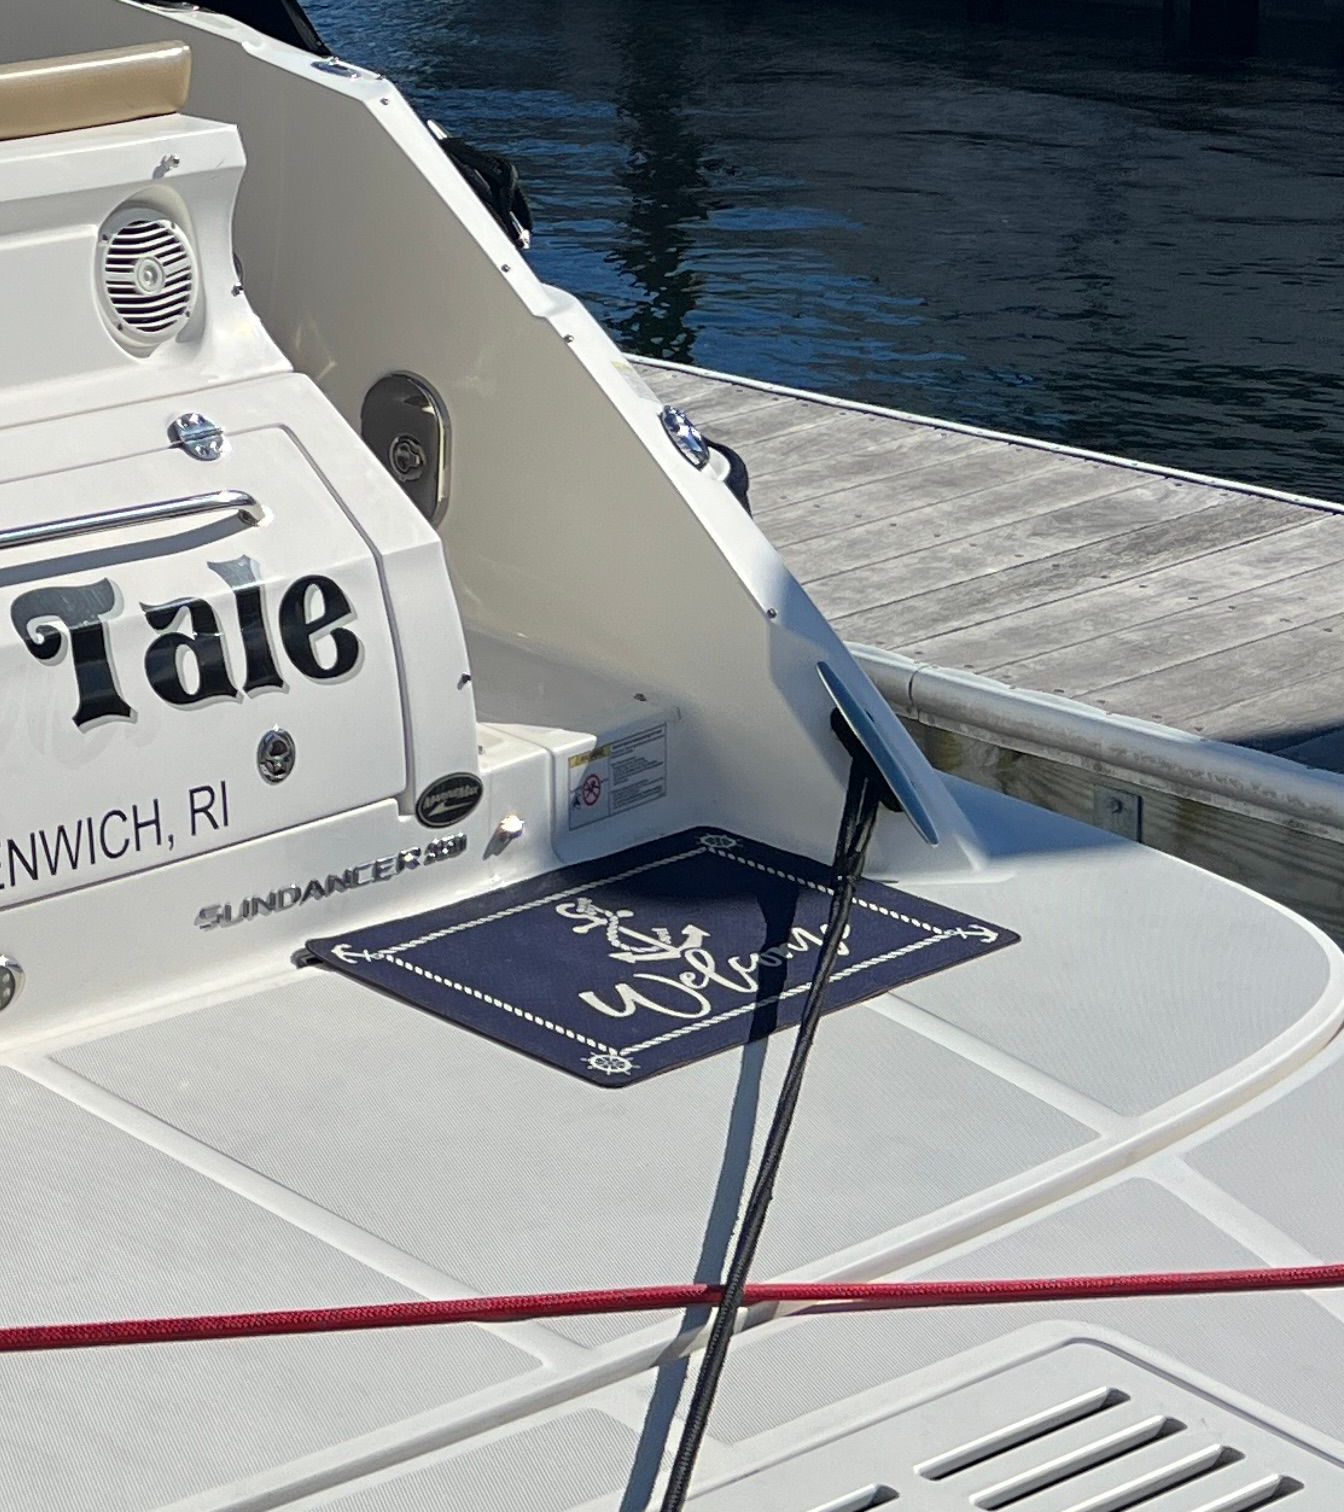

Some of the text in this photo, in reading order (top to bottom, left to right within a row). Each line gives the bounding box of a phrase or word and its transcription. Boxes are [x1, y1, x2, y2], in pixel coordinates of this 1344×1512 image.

[11, 555, 364, 732] Tale
[189, 781, 229, 836] RI
[194, 847, 421, 931] SUNDANCER
